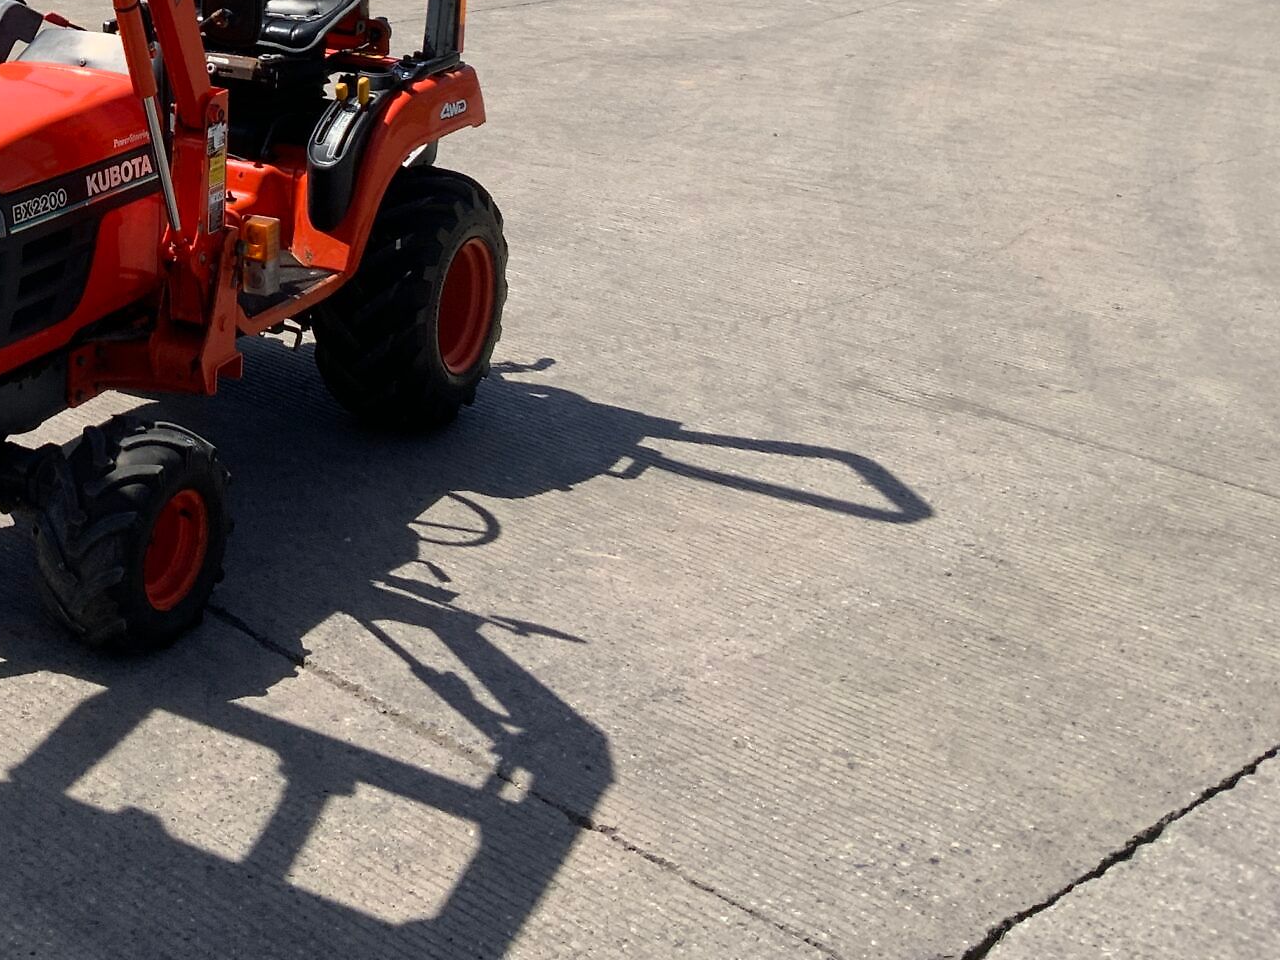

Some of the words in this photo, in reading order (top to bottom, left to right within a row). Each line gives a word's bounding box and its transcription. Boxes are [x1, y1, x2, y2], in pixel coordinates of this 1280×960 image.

[440, 99, 467, 120] 4WD
[12, 188, 68, 224] BX2200
[85, 154, 153, 197] KUBOTA
